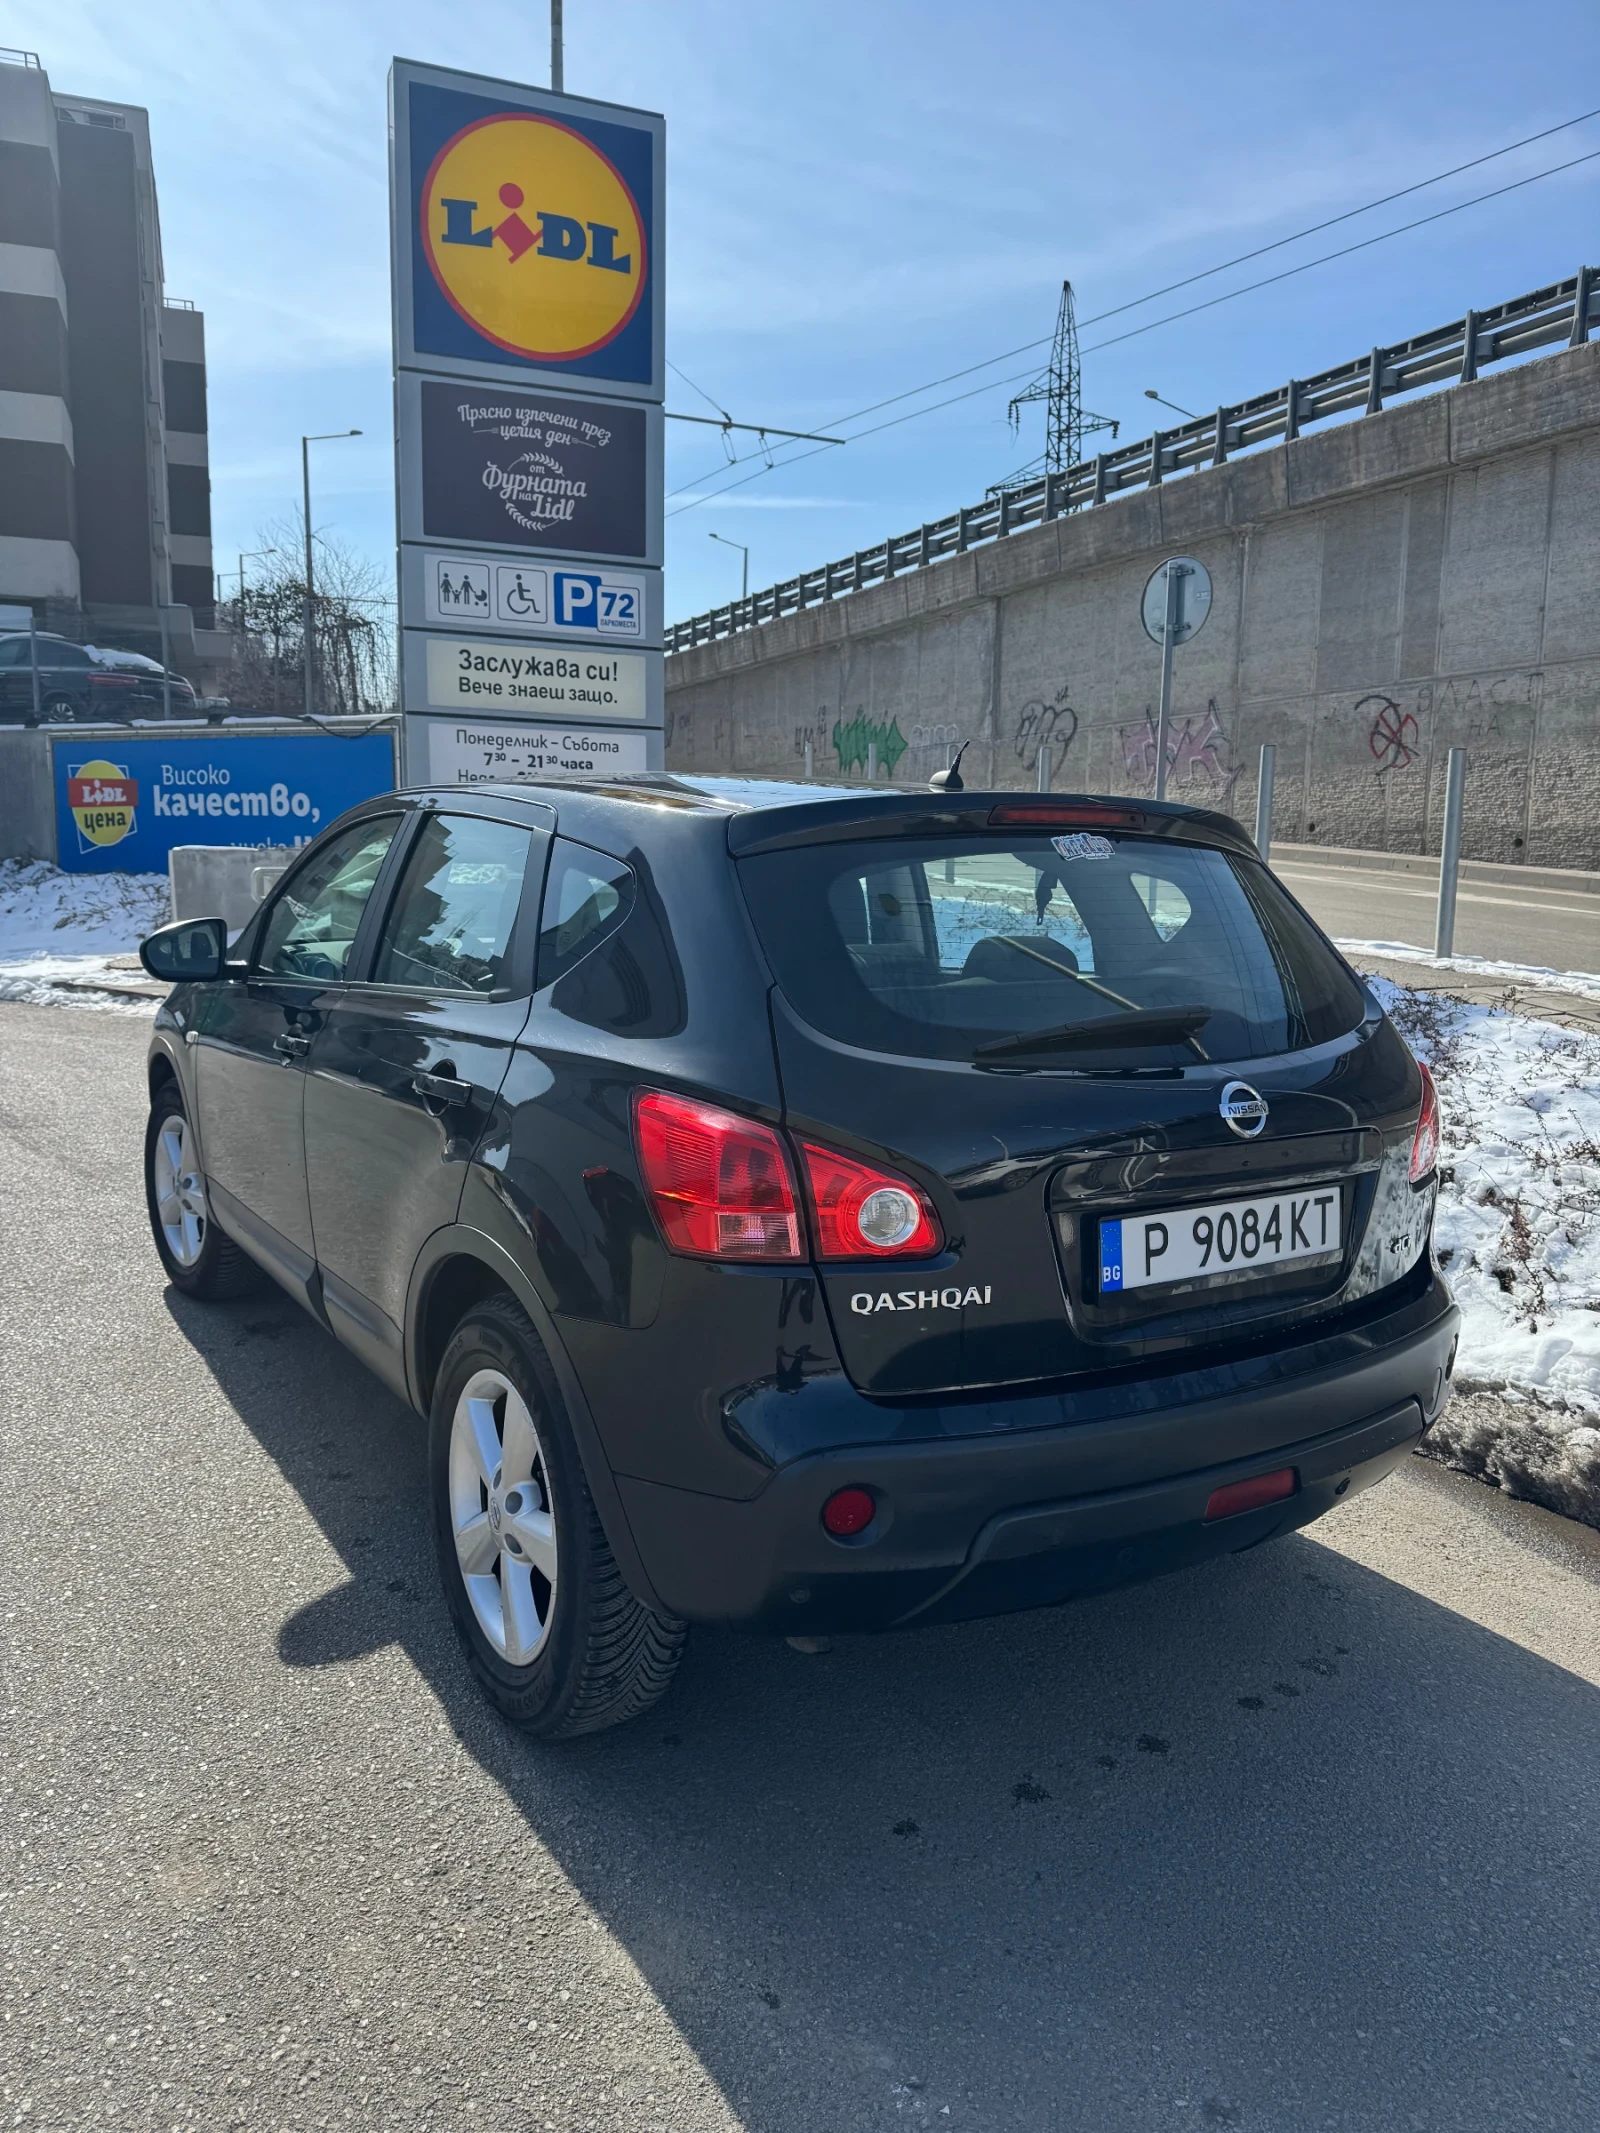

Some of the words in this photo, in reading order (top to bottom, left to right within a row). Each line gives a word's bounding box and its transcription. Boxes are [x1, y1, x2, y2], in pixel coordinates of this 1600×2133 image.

[457, 404, 512, 427] Прясно
[515, 407, 578, 429] изпечени
[581, 421, 612, 446] през
[500, 425, 542, 440] целия
[545, 430, 572, 447] ден
[482, 461, 587, 500] Фурната
[529, 464, 545, 475] от
[518, 491, 532, 502] на
[530, 494, 576, 521] Lidl
[562, 577, 593, 622] P
[600, 592, 635, 619] 72
[600, 618, 637, 628] ПАРКОМЕСТА
[458, 649, 580, 680] Заслужава
[586, 662, 618, 682] си!
[458, 676, 503, 695] Вече
[508, 683, 564, 701] знаеш
[569, 689, 618, 706] защо.
[456, 730, 549, 750] Понеделник
[562, 736, 619, 753] Събота
[160, 764, 230, 786] Високо
[560, 759, 594, 770] часа
[152, 783, 321, 824] качество,
[83, 808, 127, 834] цена
[1227, 1104, 1267, 1115] NISSAN
[1144, 1222, 1169, 1277] P
[1103, 1265, 1121, 1283] BG
[850, 1285, 992, 1316] QASHQAI
